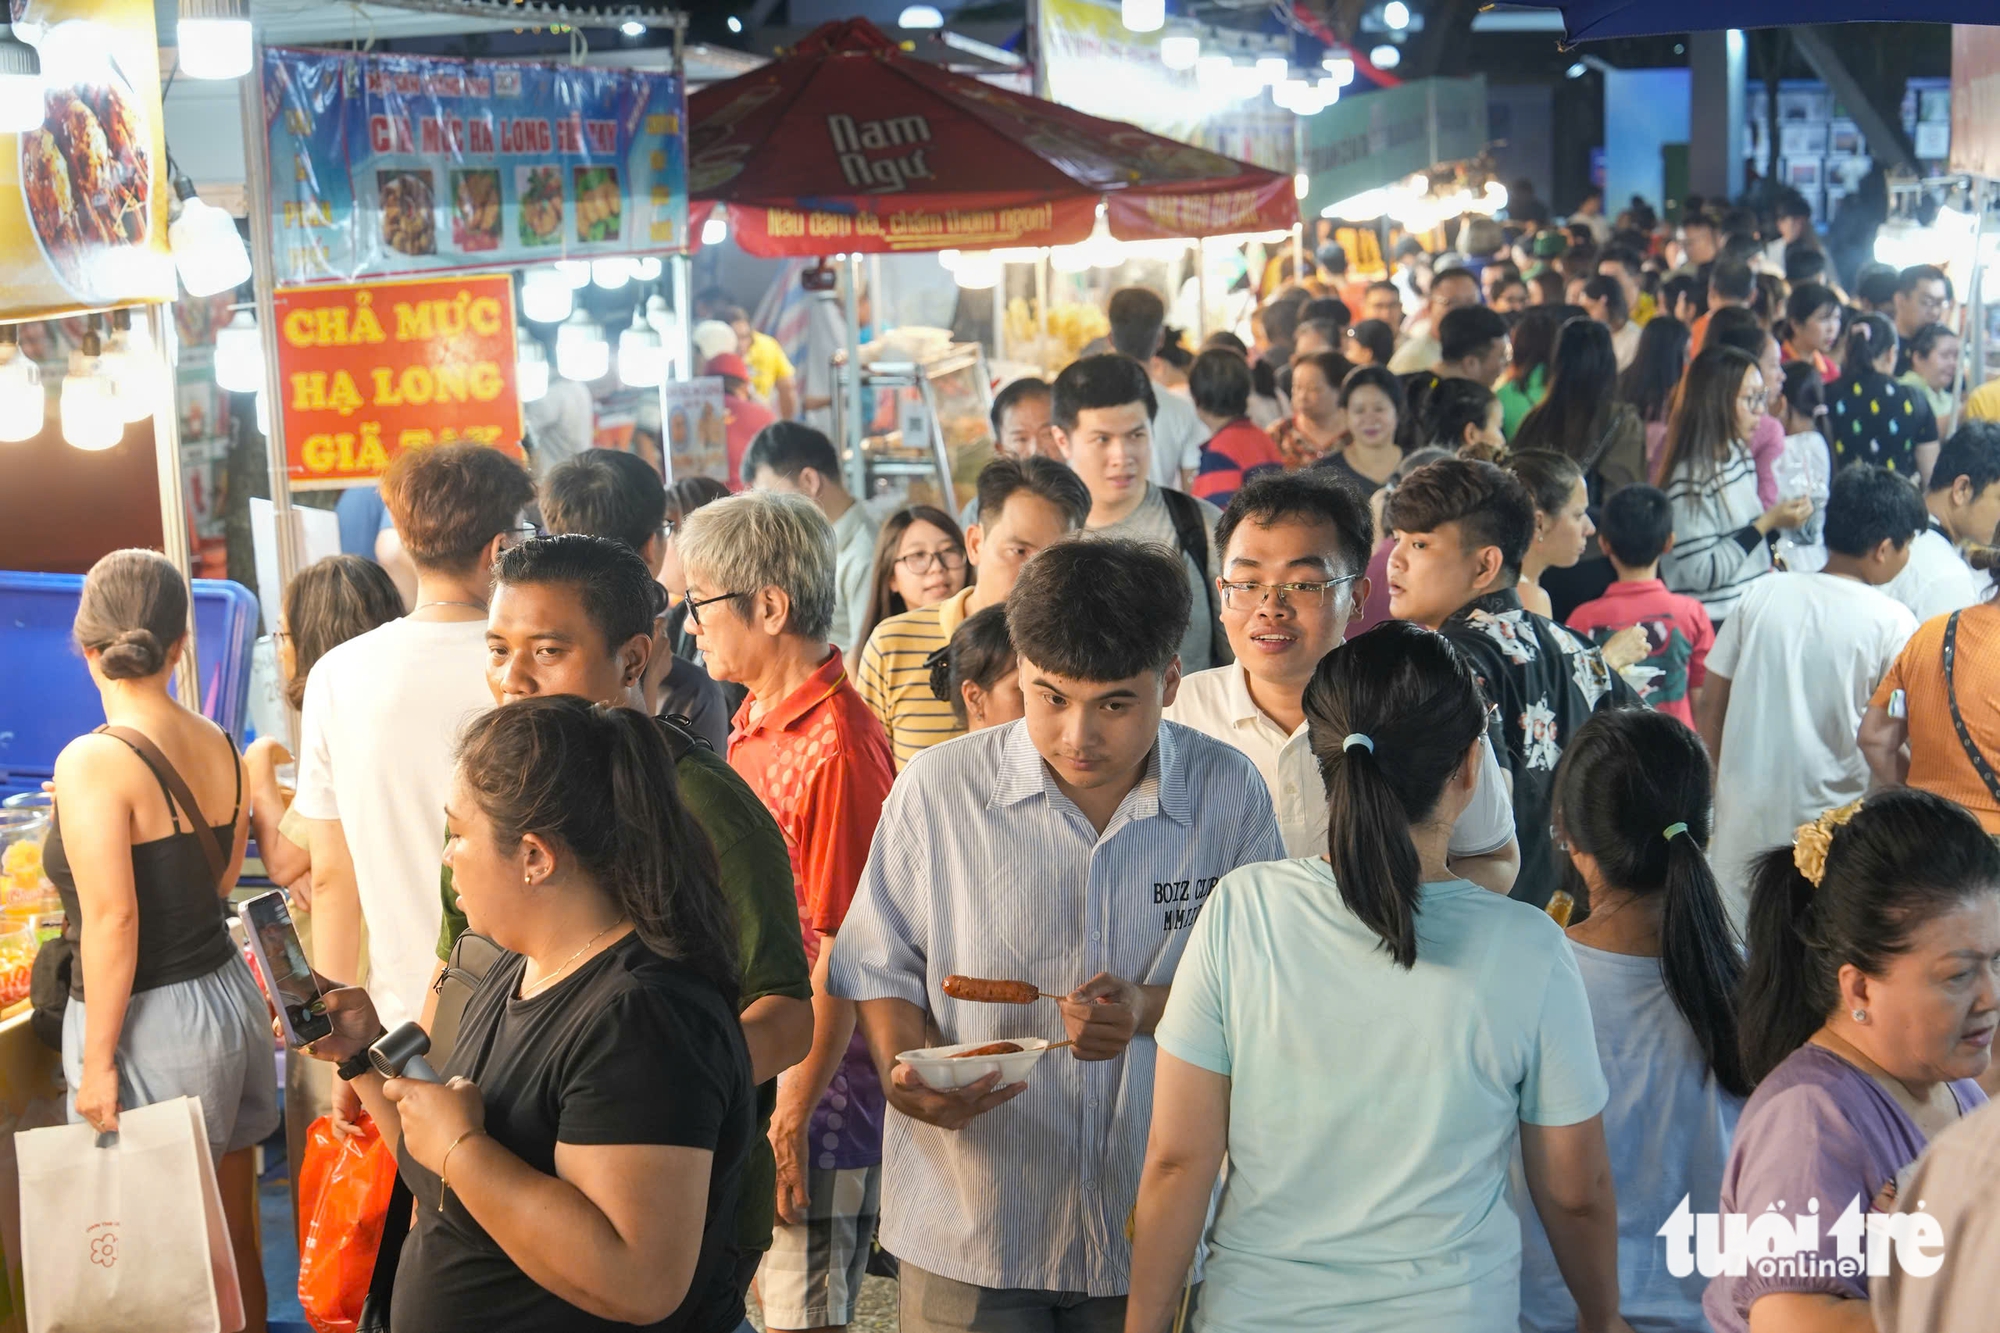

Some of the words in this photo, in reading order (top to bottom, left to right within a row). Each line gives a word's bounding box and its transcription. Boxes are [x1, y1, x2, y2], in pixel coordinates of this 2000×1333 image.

[500, 117, 551, 154] LONG
[284, 289, 387, 347] CHẢ
[290, 369, 364, 416] HẠ
[371, 361, 504, 405] LONG
[302, 421, 390, 473] GIÃ
[1153, 880, 1190, 904] BOIZ
